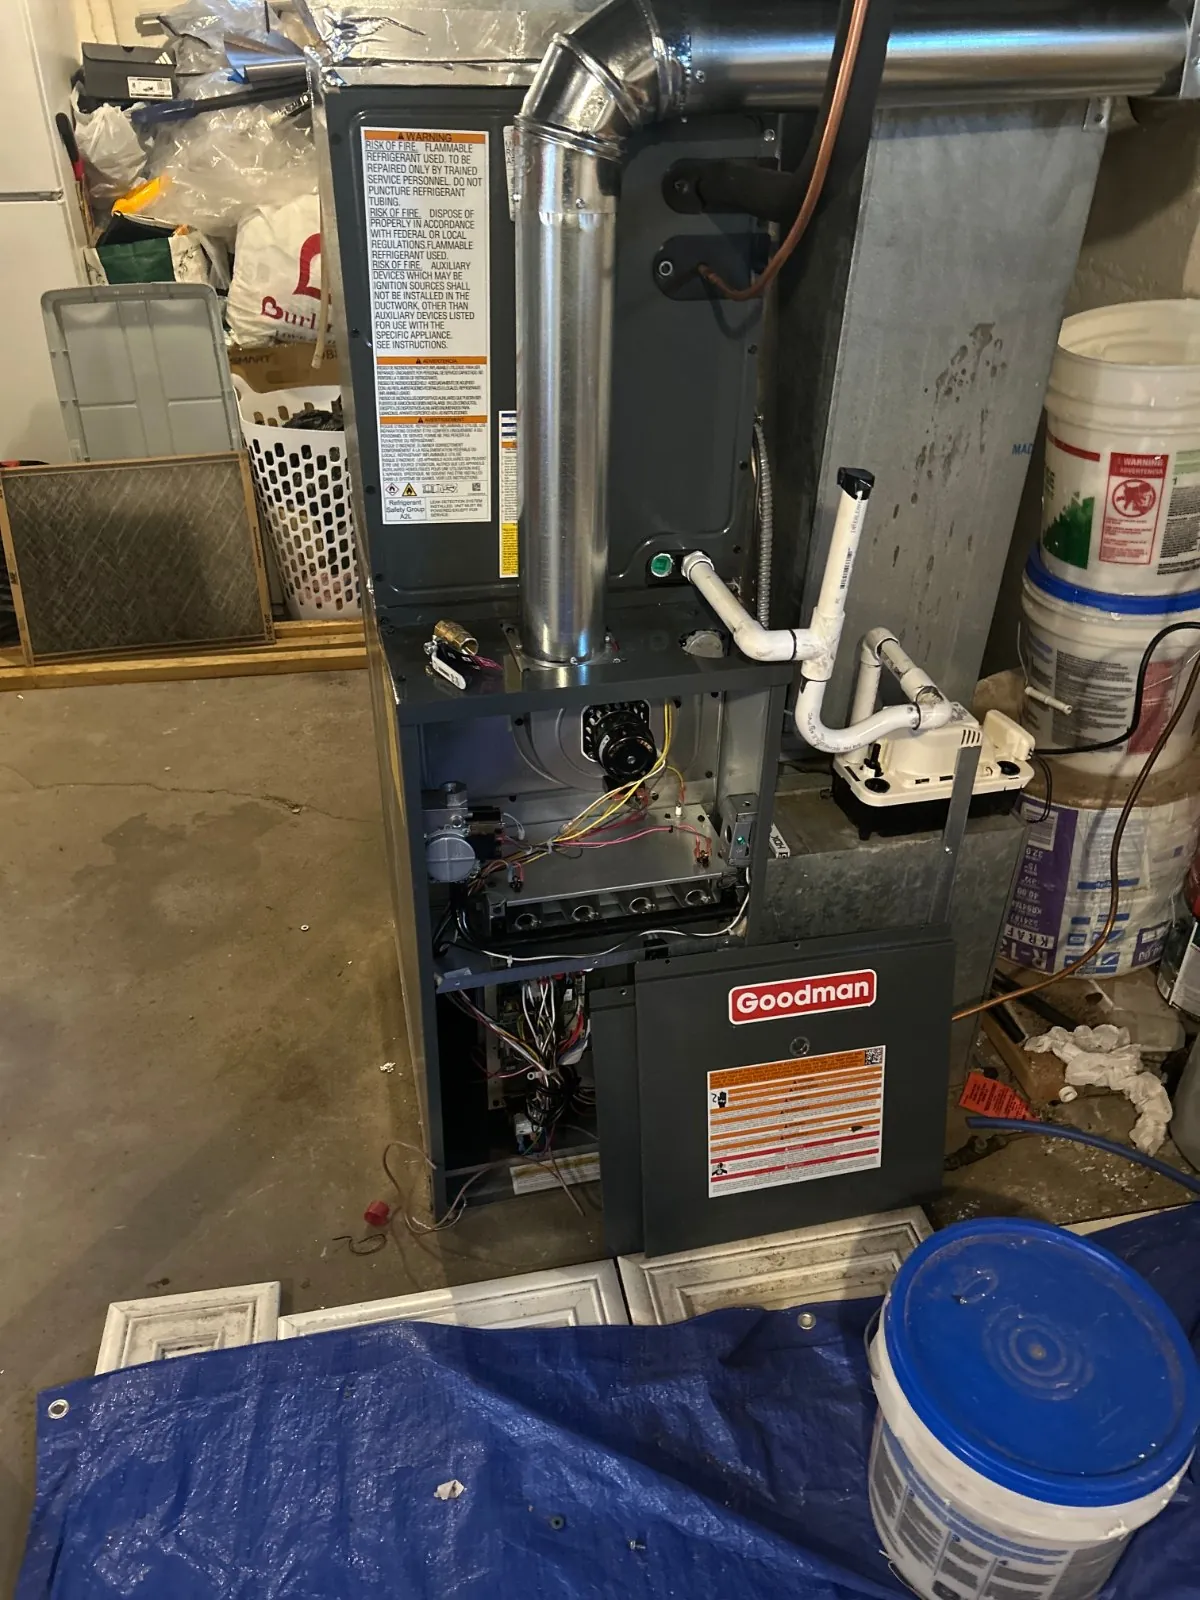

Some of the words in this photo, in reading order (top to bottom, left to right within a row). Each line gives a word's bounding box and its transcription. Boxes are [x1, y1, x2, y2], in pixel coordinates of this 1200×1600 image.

[406, 133, 452, 142] WARNING
[366, 141, 384, 151] RISK
[386, 142, 396, 151] OF
[425, 143, 473, 153] FLAMMABLE
[367, 152, 421, 162] REFRIGERANT
[449, 155, 459, 164] TO
[462, 155, 471, 164] BE
[368, 164, 406, 173] REPAIRED
[409, 165, 430, 174] ONLY
[432, 166, 442, 175] BY
[444, 166, 478, 175] TRAINED
[368, 175, 401, 184] SERVICE
[454, 177, 464, 186] DO
[467, 178, 482, 187] NOT
[369, 186, 410, 195] PUNCTURE
[413, 187, 466, 197] REFRIGERANT
[370, 197, 401, 206] TUBING.
[370, 208, 389, 217] RISK
[390, 208, 400, 217] OF
[430, 209, 462, 218] DISPOSE
[465, 210, 475, 218] OF
[370, 219, 411, 228] PROPERLY
[414, 220, 422, 228] IN
[424, 220, 475, 229] ACCORDANCE
[371, 229, 391, 238] WITH
[394, 230, 427, 239] FEDERAL
[429, 230, 440, 239] OR
[442, 230, 467, 239] LOCAL
[372, 251, 425, 260] REFRIGERANT
[427, 251, 448, 260] USED.
[373, 261, 390, 269] RISK
[392, 261, 402, 269] OF
[431, 262, 471, 270] AUXILIARY
[374, 272, 405, 280] DEVICES
[406, 272, 433, 280] WHICH
[435, 272, 452, 280] MAY
[454, 272, 463, 280] BE
[374, 282, 408, 290] IGNITION
[410, 282, 445, 290] SOURCES
[446, 282, 470, 291] SHALL
[374, 292, 389, 300] NOT
[392, 292, 401, 300] BE
[404, 292, 444, 300] INSTALLED
[446, 292, 454, 300] IN
[456, 292, 470, 300] THE
[422, 302, 447, 310] OTHER
[449, 302, 468, 310] THAN
[375, 312, 415, 320] AUXILIARY
[417, 312, 447, 320] DEVICES
[449, 312, 475, 320] LISTED
[376, 331, 409, 339] SPECIFIC
[377, 341, 390, 349] SEE
[393, 341, 448, 349] INSTRUCTIONS.
[1124, 458, 1163, 467] WARNING
[737, 980, 869, 1014] Goodman
